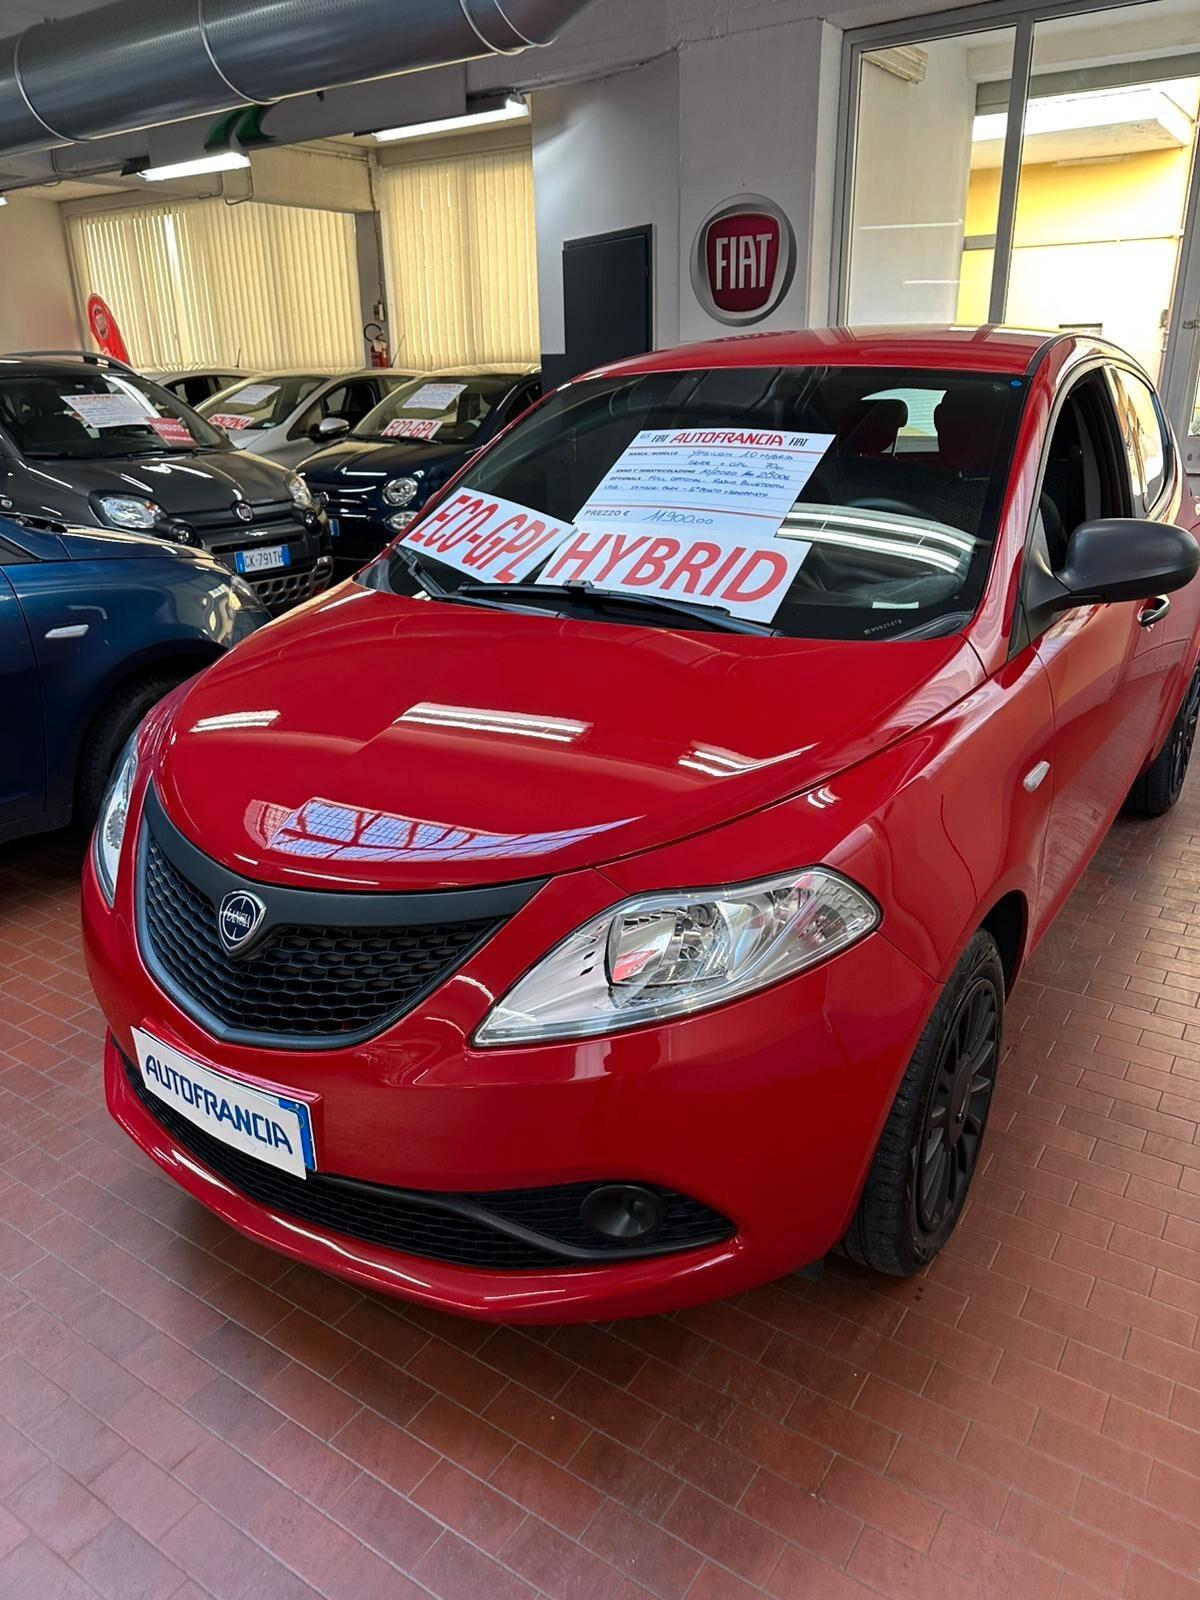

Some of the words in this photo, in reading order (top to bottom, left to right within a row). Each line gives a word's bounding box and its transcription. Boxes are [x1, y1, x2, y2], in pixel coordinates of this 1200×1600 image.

[716, 233, 773, 290] FIAT
[385, 420, 438, 439] ECO-GPL
[651, 434, 670, 443] FIAT
[670, 431, 784, 447] AUTOFRANCIA
[788, 437, 810, 447] FIAT
[409, 494, 561, 584] ECO-GPL
[546, 533, 789, 602] HYBRID
[146, 1055, 293, 1155] AUTOFRANCIA
